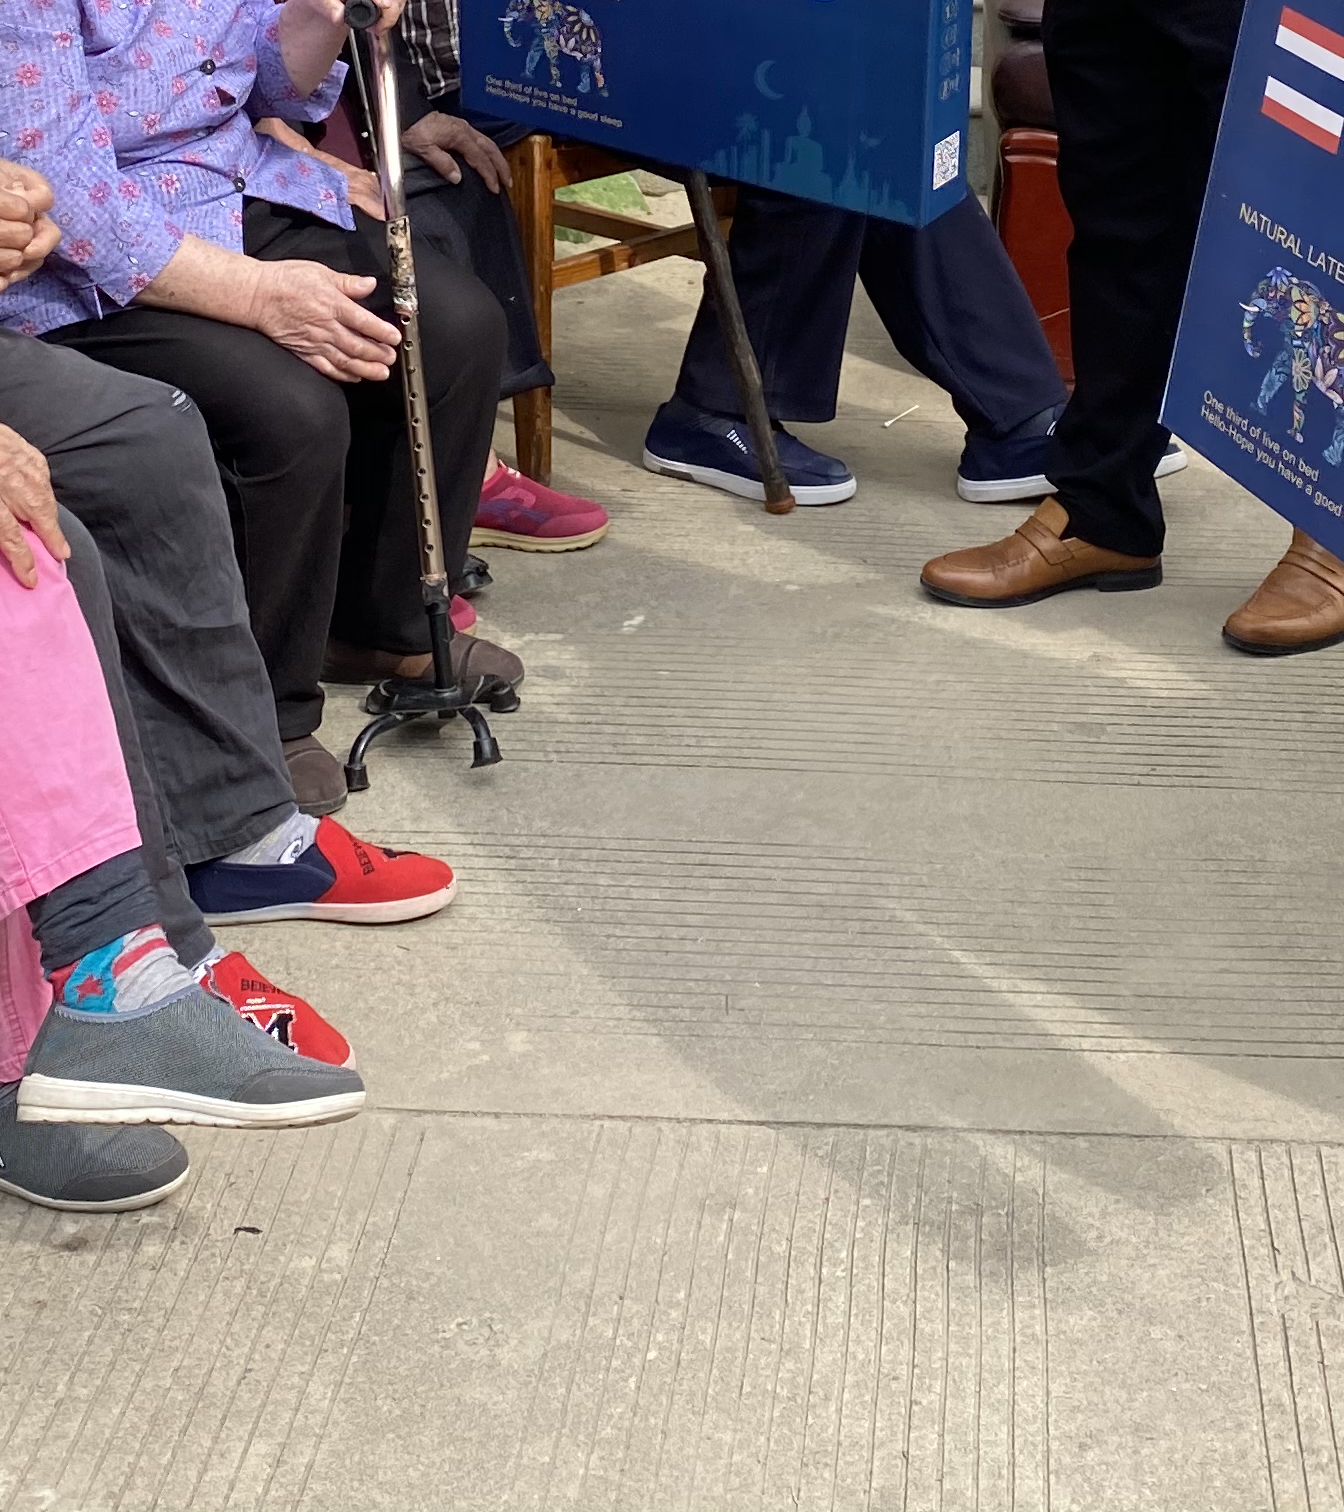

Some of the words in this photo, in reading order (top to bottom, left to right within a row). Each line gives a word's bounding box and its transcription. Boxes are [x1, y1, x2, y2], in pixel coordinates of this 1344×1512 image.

[1239, 202, 1304, 259] NATURAL
[1200, 404, 1256, 455] Hello-Hope
[1256, 447, 1277, 470] you
[1277, 460, 1305, 490] have
[1304, 483, 1314, 496] a
[1313, 490, 1344, 518] good
[1203, 390, 1225, 414] One
[1225, 401, 1249, 432] third
[1249, 425, 1262, 440] of
[1262, 431, 1281, 454] live
[1282, 448, 1297, 466] on
[1297, 458, 1320, 483] bed
